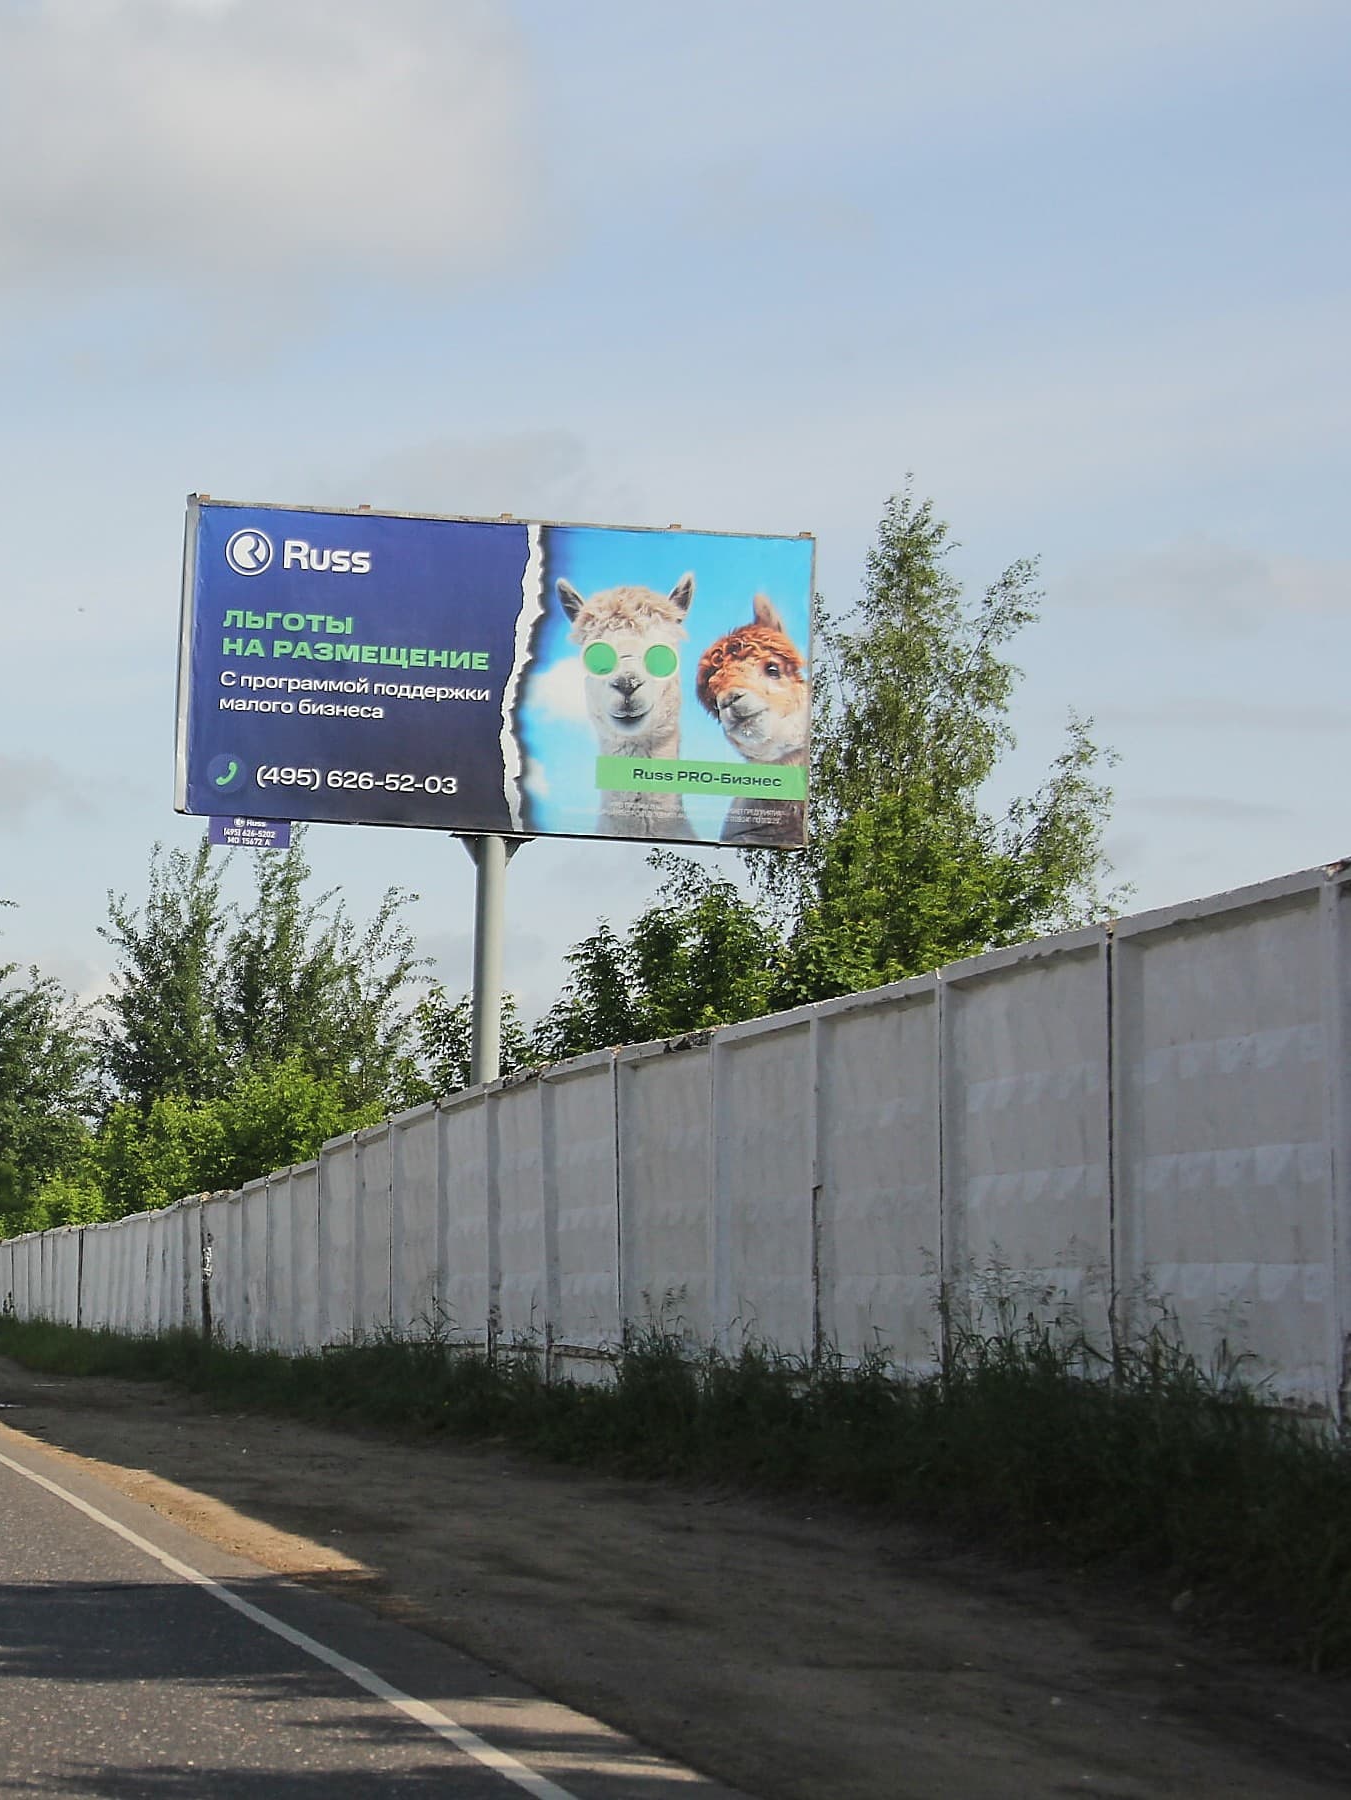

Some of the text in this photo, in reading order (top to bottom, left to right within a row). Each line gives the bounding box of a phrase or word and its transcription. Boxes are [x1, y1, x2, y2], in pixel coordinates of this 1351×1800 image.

[283, 540, 372, 575] Russ
[222, 609, 353, 635] ЛЬГОТЫ
[222, 638, 490, 671] НА РАЗМЕЩЕНИЕ
[220, 671, 490, 702] С программой поддержки
[218, 698, 384, 719] малого бизнеса
[256, 765, 458, 795] (495) 626-52-03
[632, 768, 782, 788] Russ PRO-Бизнес
[242, 830, 276, 838] 626-5202
[246, 819, 267, 827] Russ
